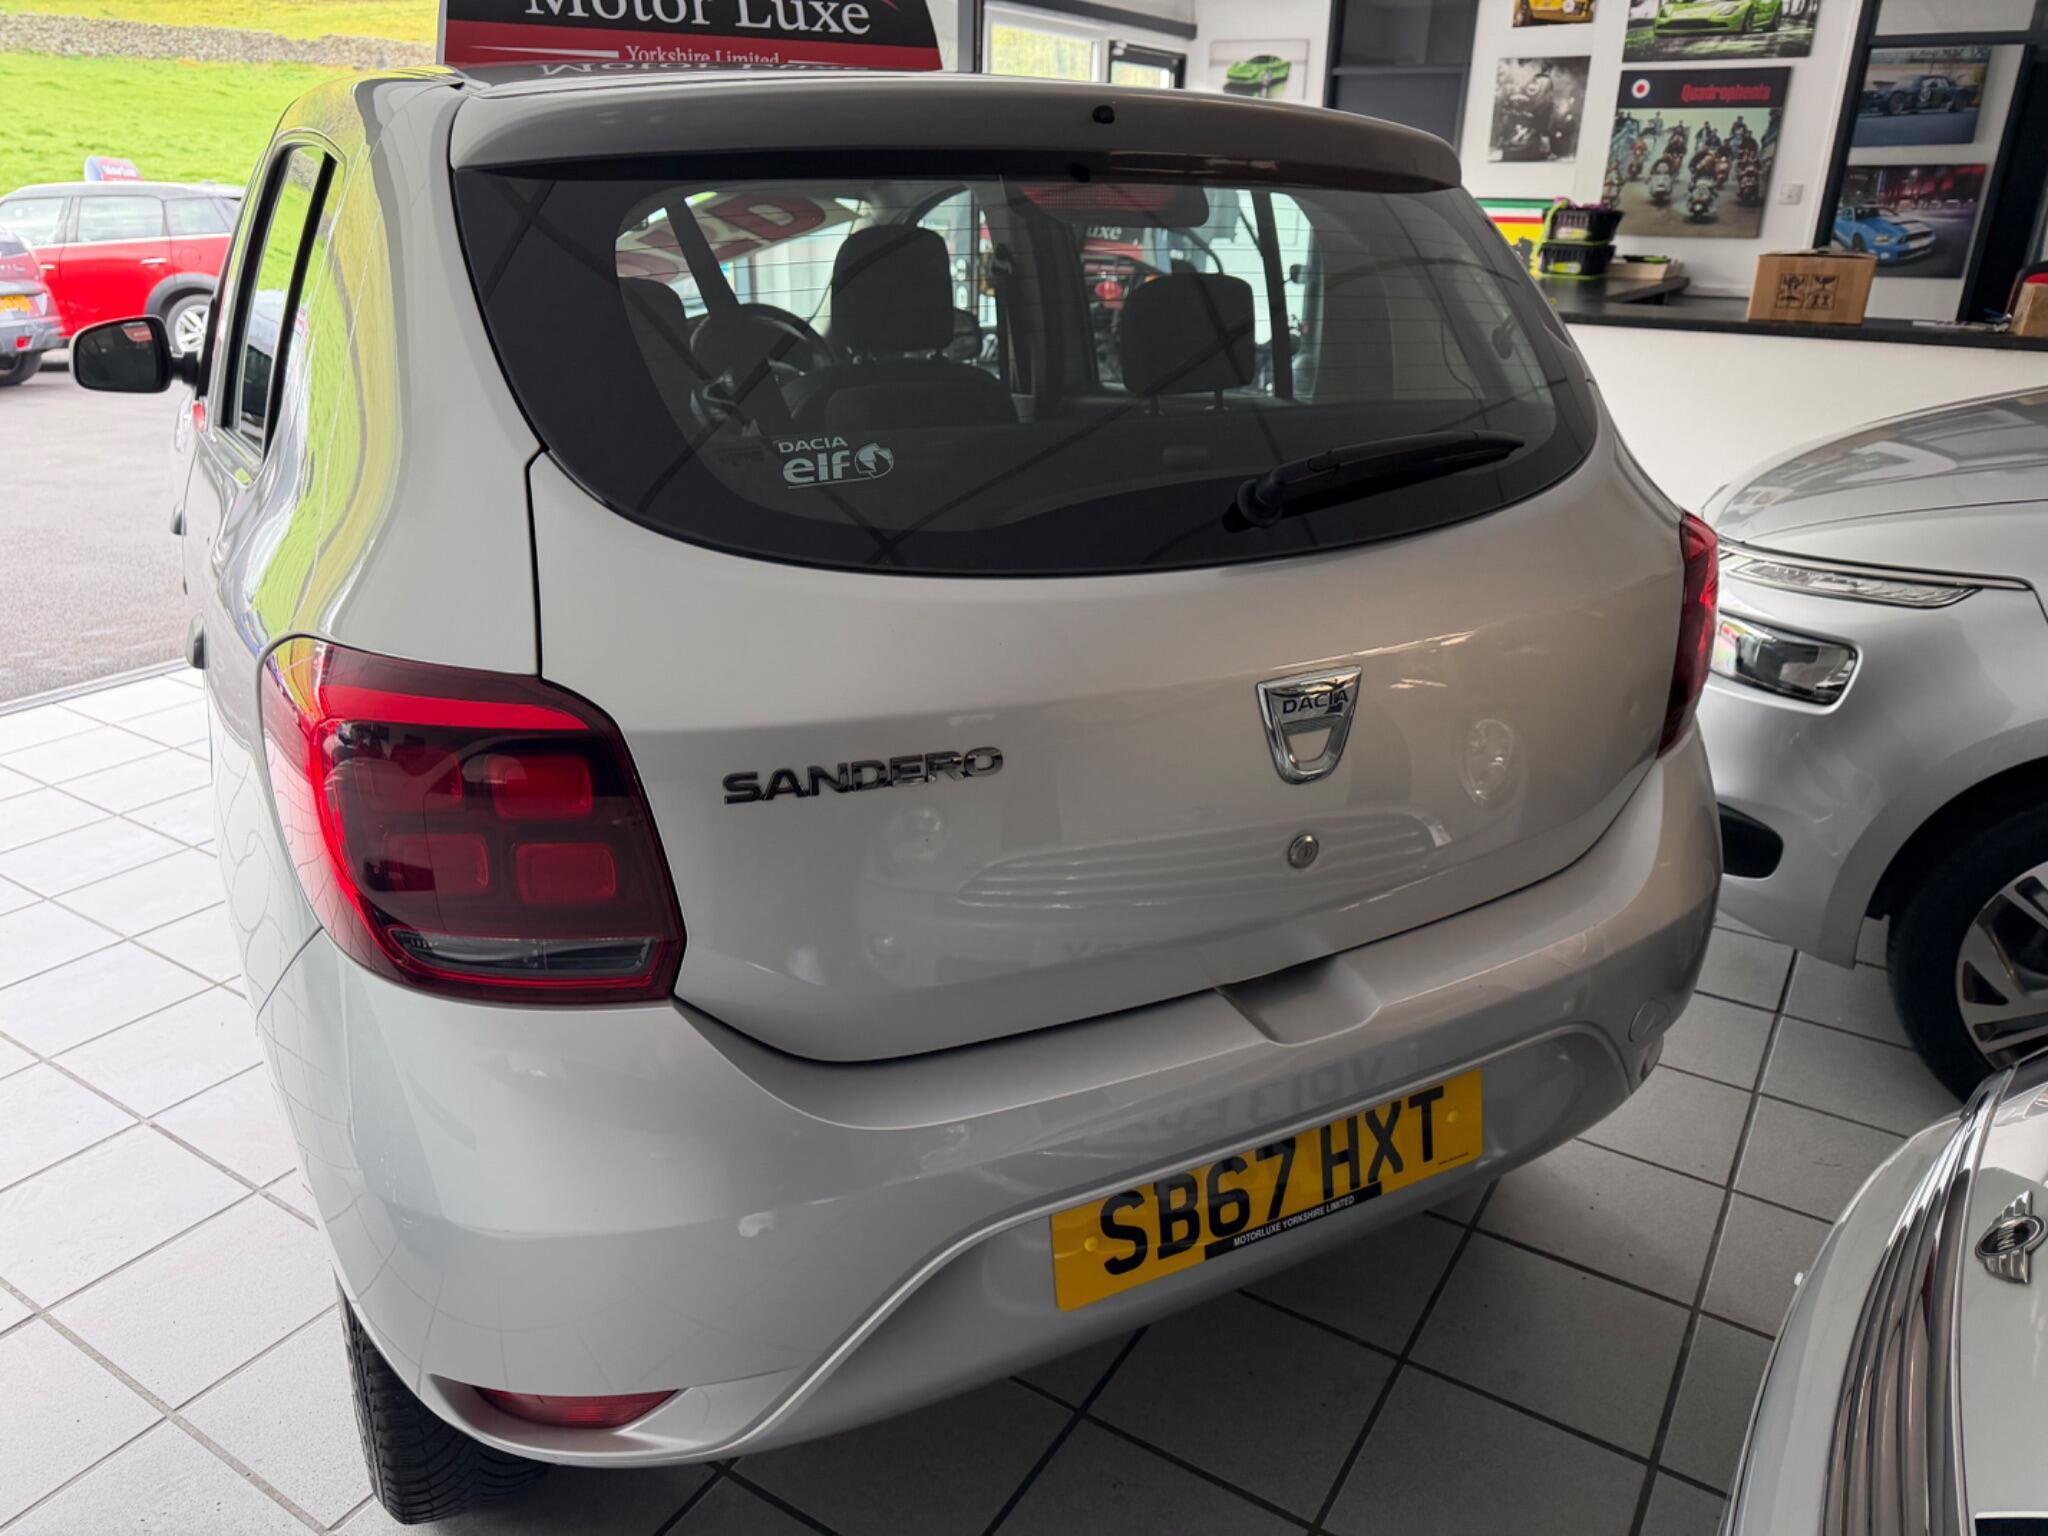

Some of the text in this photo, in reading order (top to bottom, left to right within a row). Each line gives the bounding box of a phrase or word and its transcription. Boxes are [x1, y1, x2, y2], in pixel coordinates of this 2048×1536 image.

[736, 0, 871, 35] Luxe
[625, 45, 711, 63] Yorkshire
[778, 436, 848, 453] DACIA
[783, 450, 850, 483] elf
[1283, 689, 1348, 713] DACIA
[722, 746, 1003, 805] SANDERO
[1100, 1085, 1444, 1275] SB67 HXT
[1233, 1194, 1355, 1247] MOTORLUXE YORKSHIRE LIMITED
